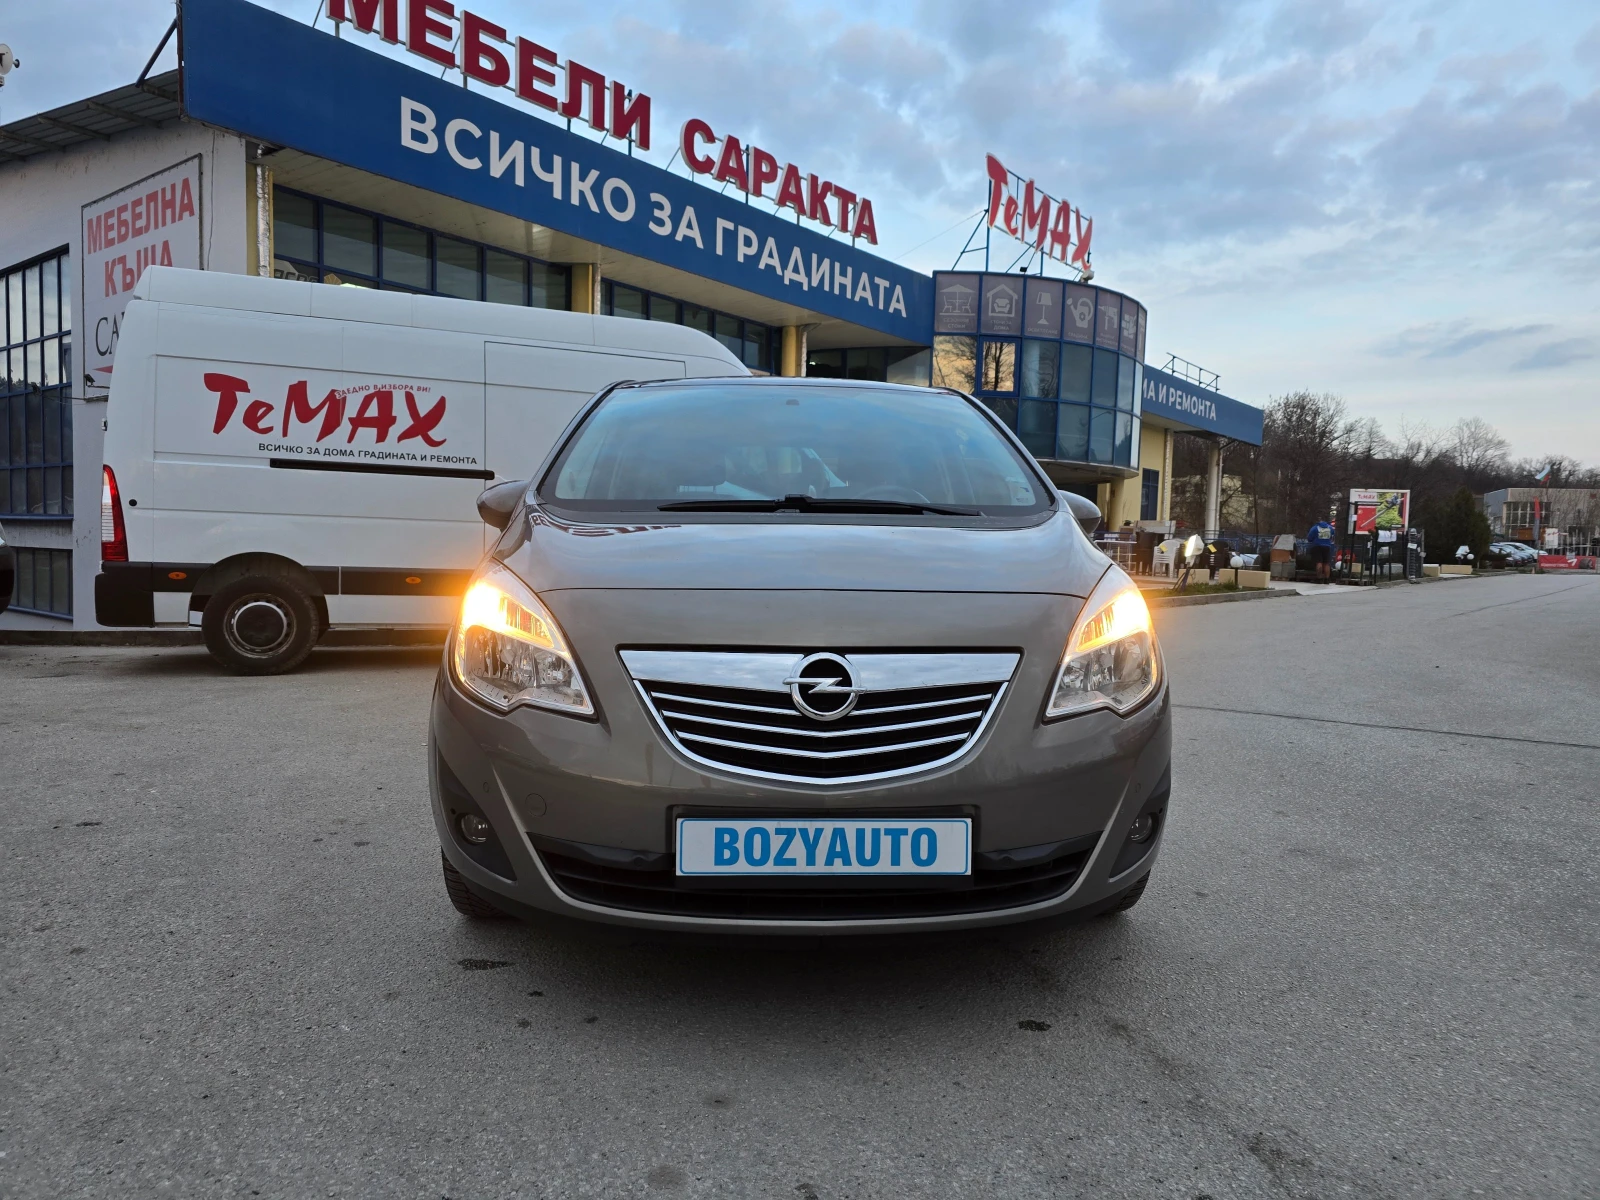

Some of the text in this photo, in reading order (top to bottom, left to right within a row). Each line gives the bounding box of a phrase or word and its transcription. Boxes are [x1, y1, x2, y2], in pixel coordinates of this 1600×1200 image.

[322, 0, 878, 245] МЕБЕЛИ САРАКТА
[87, 177, 195, 255] МЕБЕЛНА
[401, 96, 907, 317] ВСИЧКО ЗА ГРАДИНАТА
[335, 385, 371, 399] ЗАЕДНО
[380, 383, 414, 391] ИЗБОРА
[416, 385, 431, 393] ВИ!
[1158, 383, 1167, 404] И
[1168, 387, 1217, 421] РЕМОНТА
[258, 442, 478, 465] ВСИЧКО ЗА ДОМА ГРАДИНАТА И РЕМОНТА
[713, 826, 939, 868] BOZYAUTO
